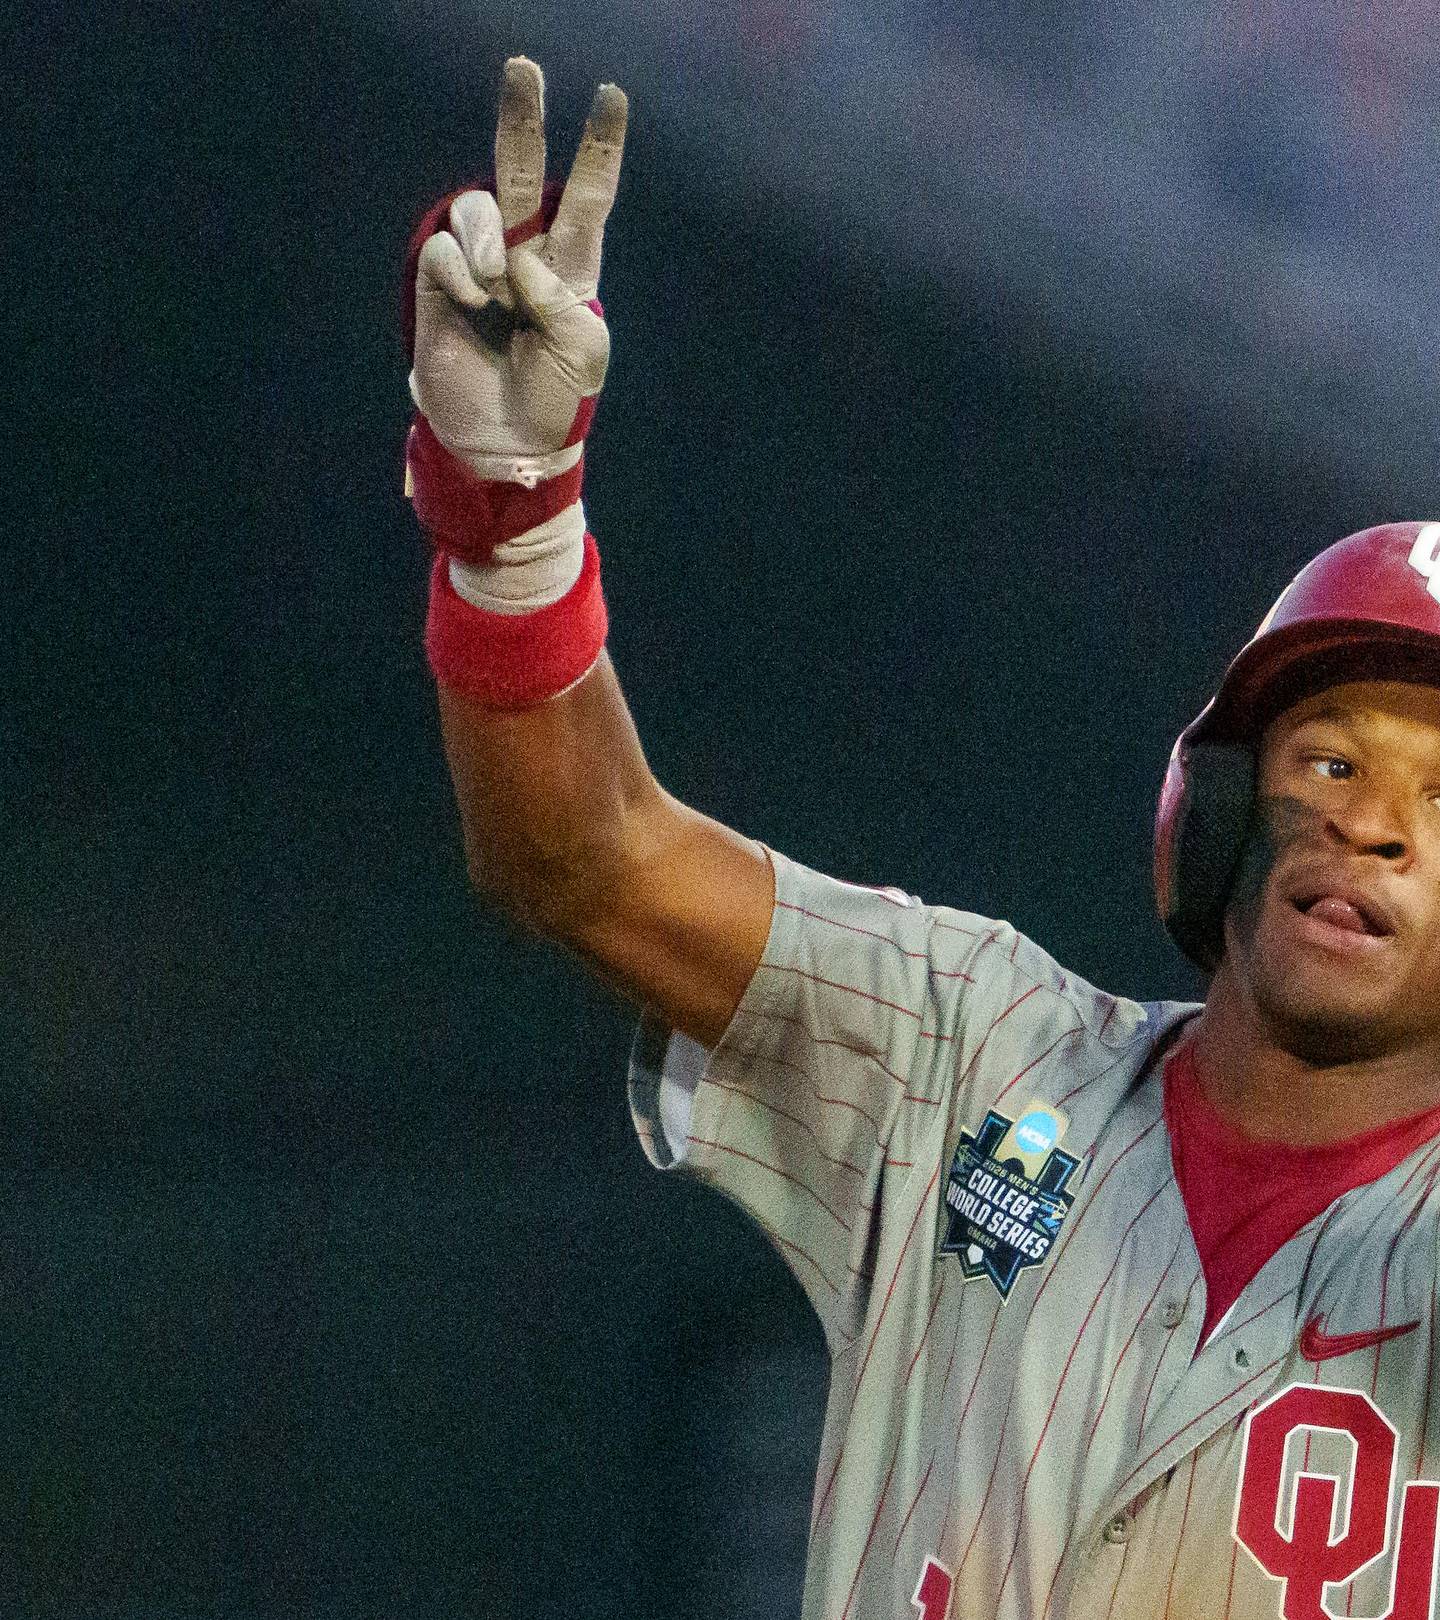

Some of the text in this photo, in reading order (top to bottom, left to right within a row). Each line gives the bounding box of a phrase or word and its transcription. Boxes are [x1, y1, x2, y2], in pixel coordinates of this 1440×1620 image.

[968, 1168, 1040, 1222] COLLEGE
[1008, 1173, 1039, 1196] MEN'S
[947, 1182, 1050, 1260] WORLD SERIES
